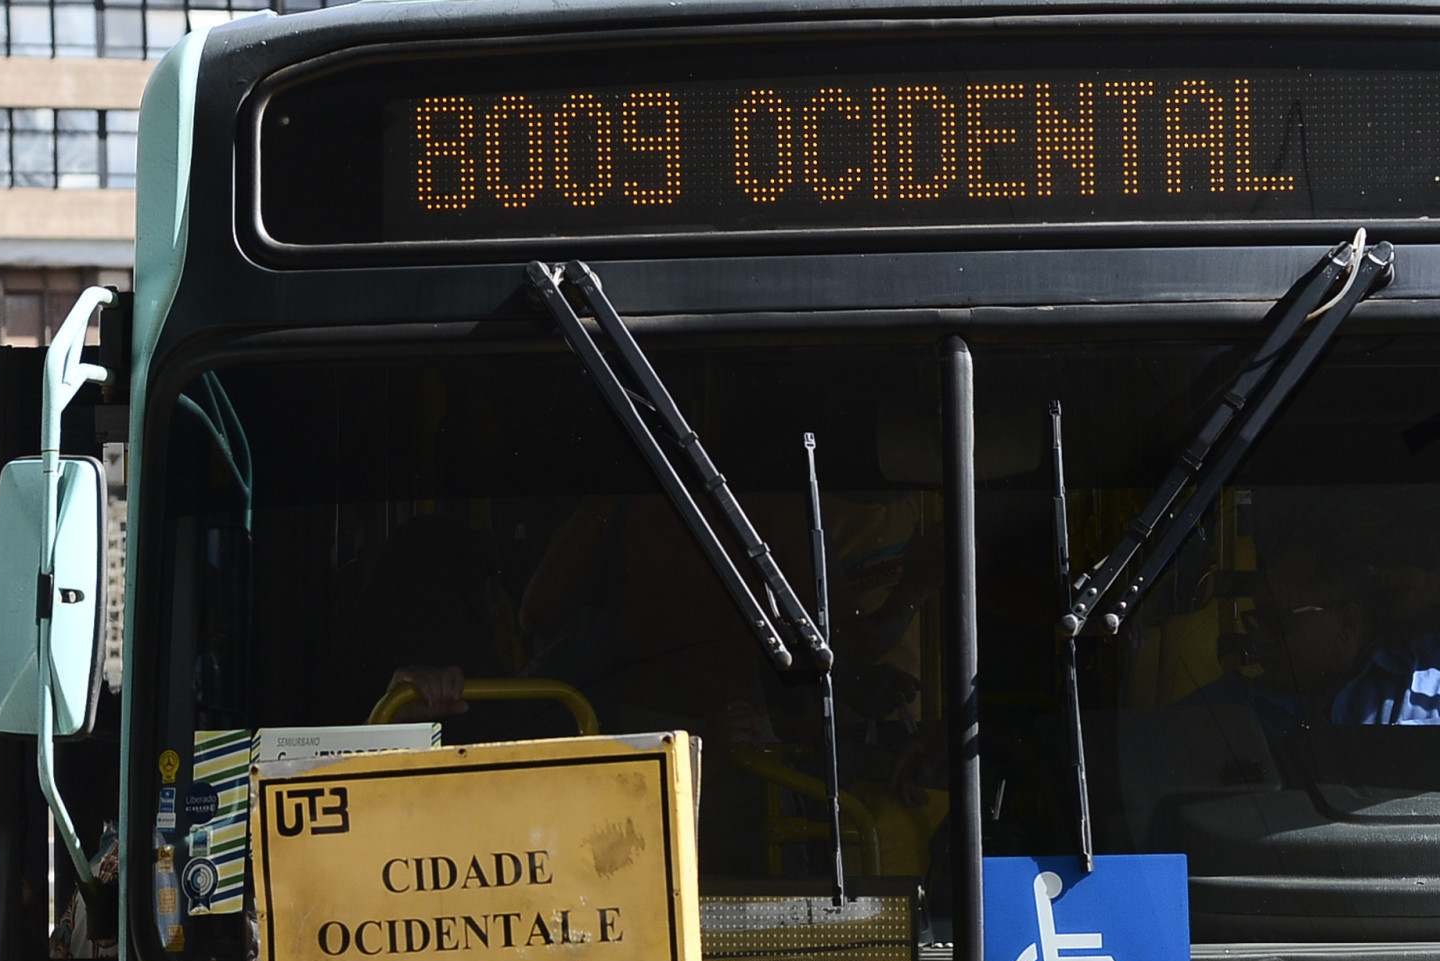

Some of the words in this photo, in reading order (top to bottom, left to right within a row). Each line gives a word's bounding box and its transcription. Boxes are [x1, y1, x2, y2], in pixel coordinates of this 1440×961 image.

[417, 92, 680, 208] 8009
[734, 79, 1294, 201] OCIDENTAL
[275, 787, 349, 837] UTB
[382, 850, 553, 893] CIDADE
[318, 909, 585, 956] OCIDENTAL
[596, 907, 624, 943] E
